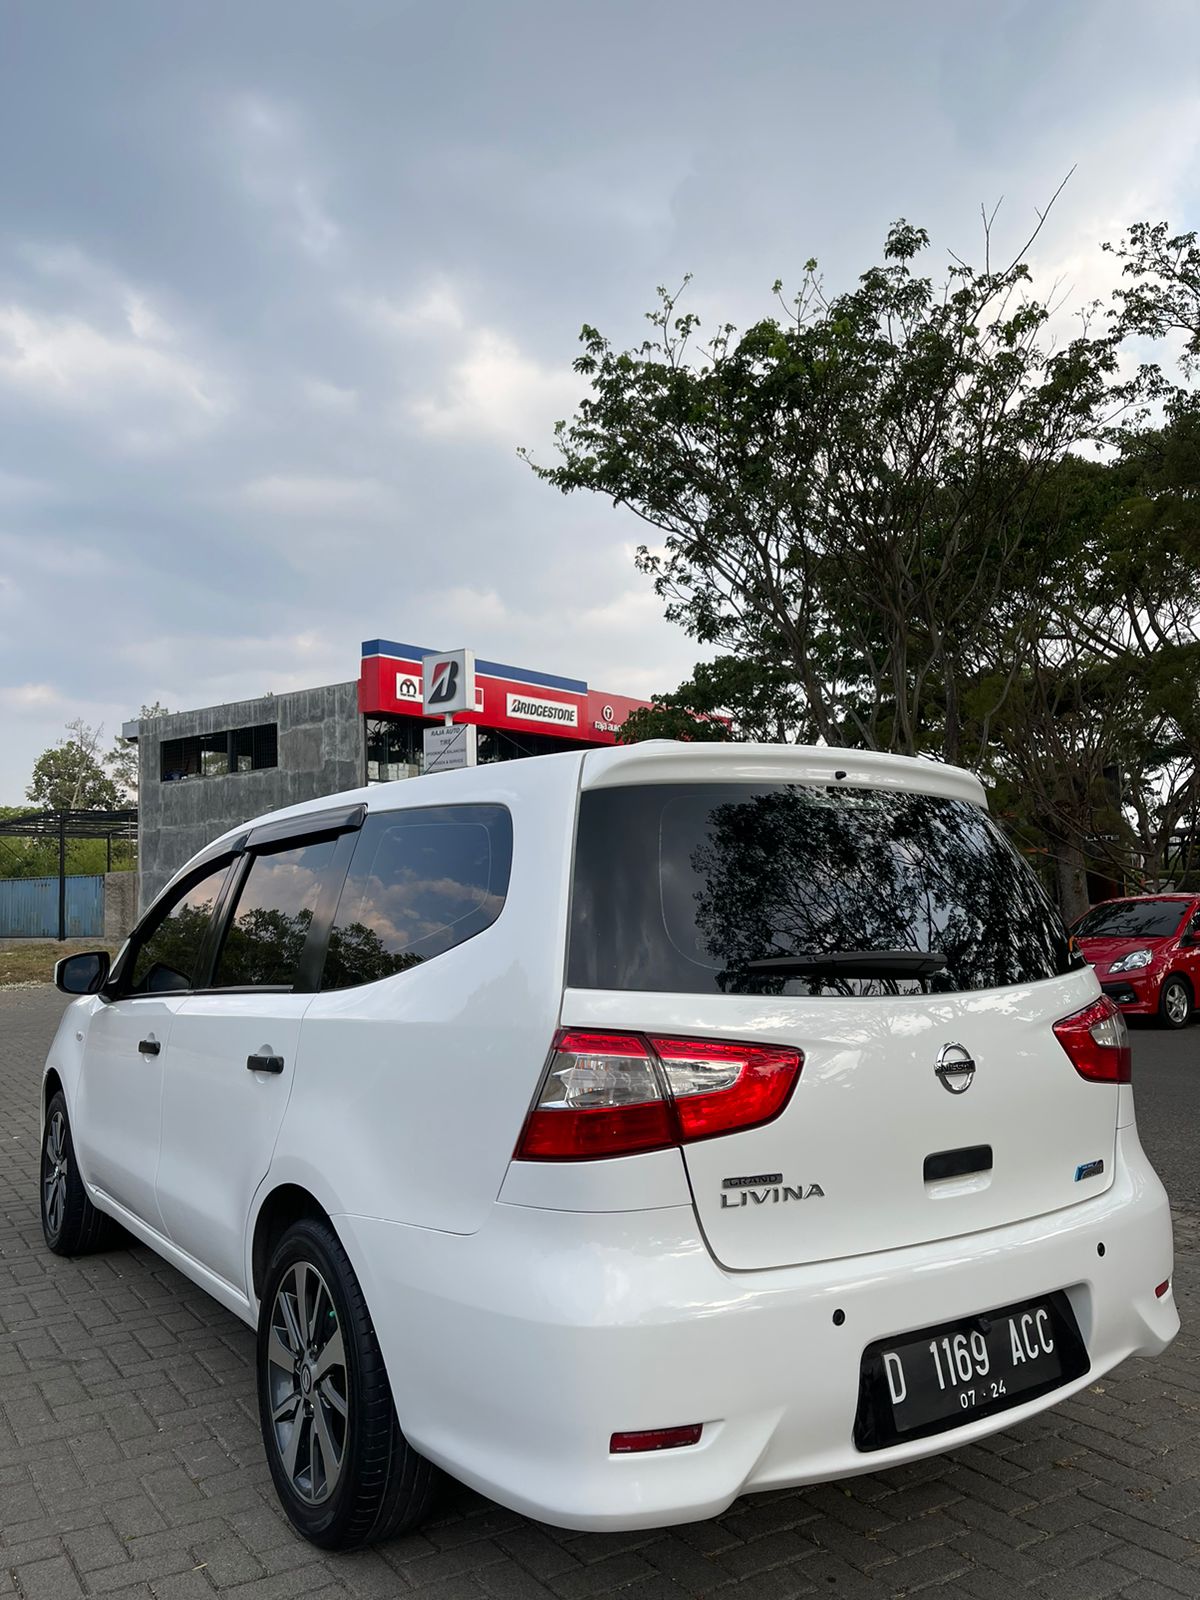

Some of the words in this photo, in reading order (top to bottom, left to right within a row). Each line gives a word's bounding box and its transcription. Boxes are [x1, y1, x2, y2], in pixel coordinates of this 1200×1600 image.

[511, 699, 575, 722] BRIDGESTONE
[446, 727, 461, 735] AUTO
[729, 1174, 778, 1187] GRAND
[720, 1183, 825, 1208] LIVINA
[883, 1352, 907, 1405] D
[929, 1330, 990, 1390] 1169
[1008, 1309, 1054, 1366] ACC
[960, 1389, 976, 1409] 07
[990, 1379, 1007, 1398] 24
